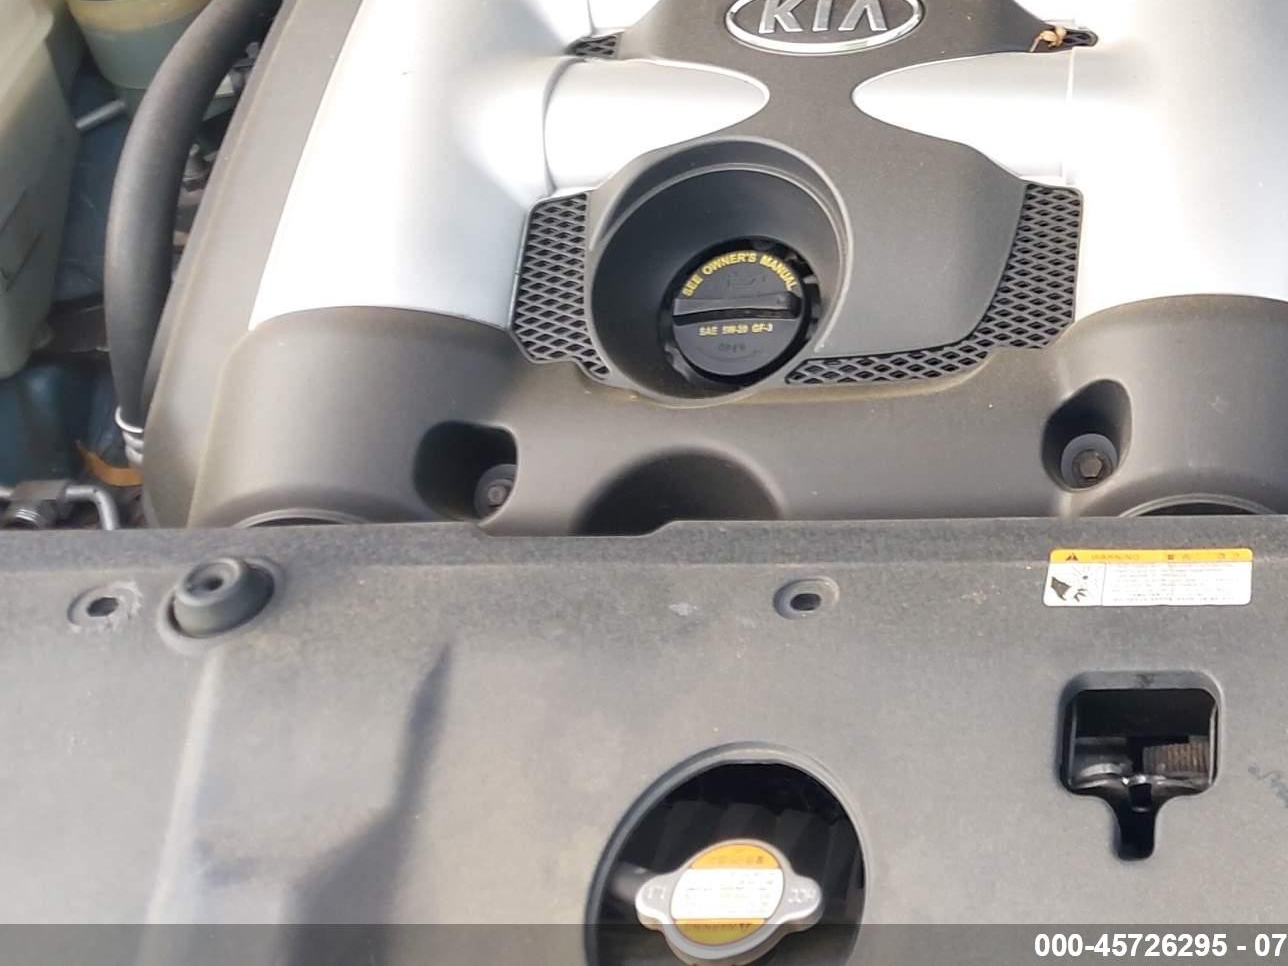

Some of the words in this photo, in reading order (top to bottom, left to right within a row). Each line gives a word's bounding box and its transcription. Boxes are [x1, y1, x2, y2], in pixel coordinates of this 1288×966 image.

[702, 252, 757, 275] OWNER'S
[759, 254, 798, 291] MANUAL
[699, 325, 719, 336] SAE
